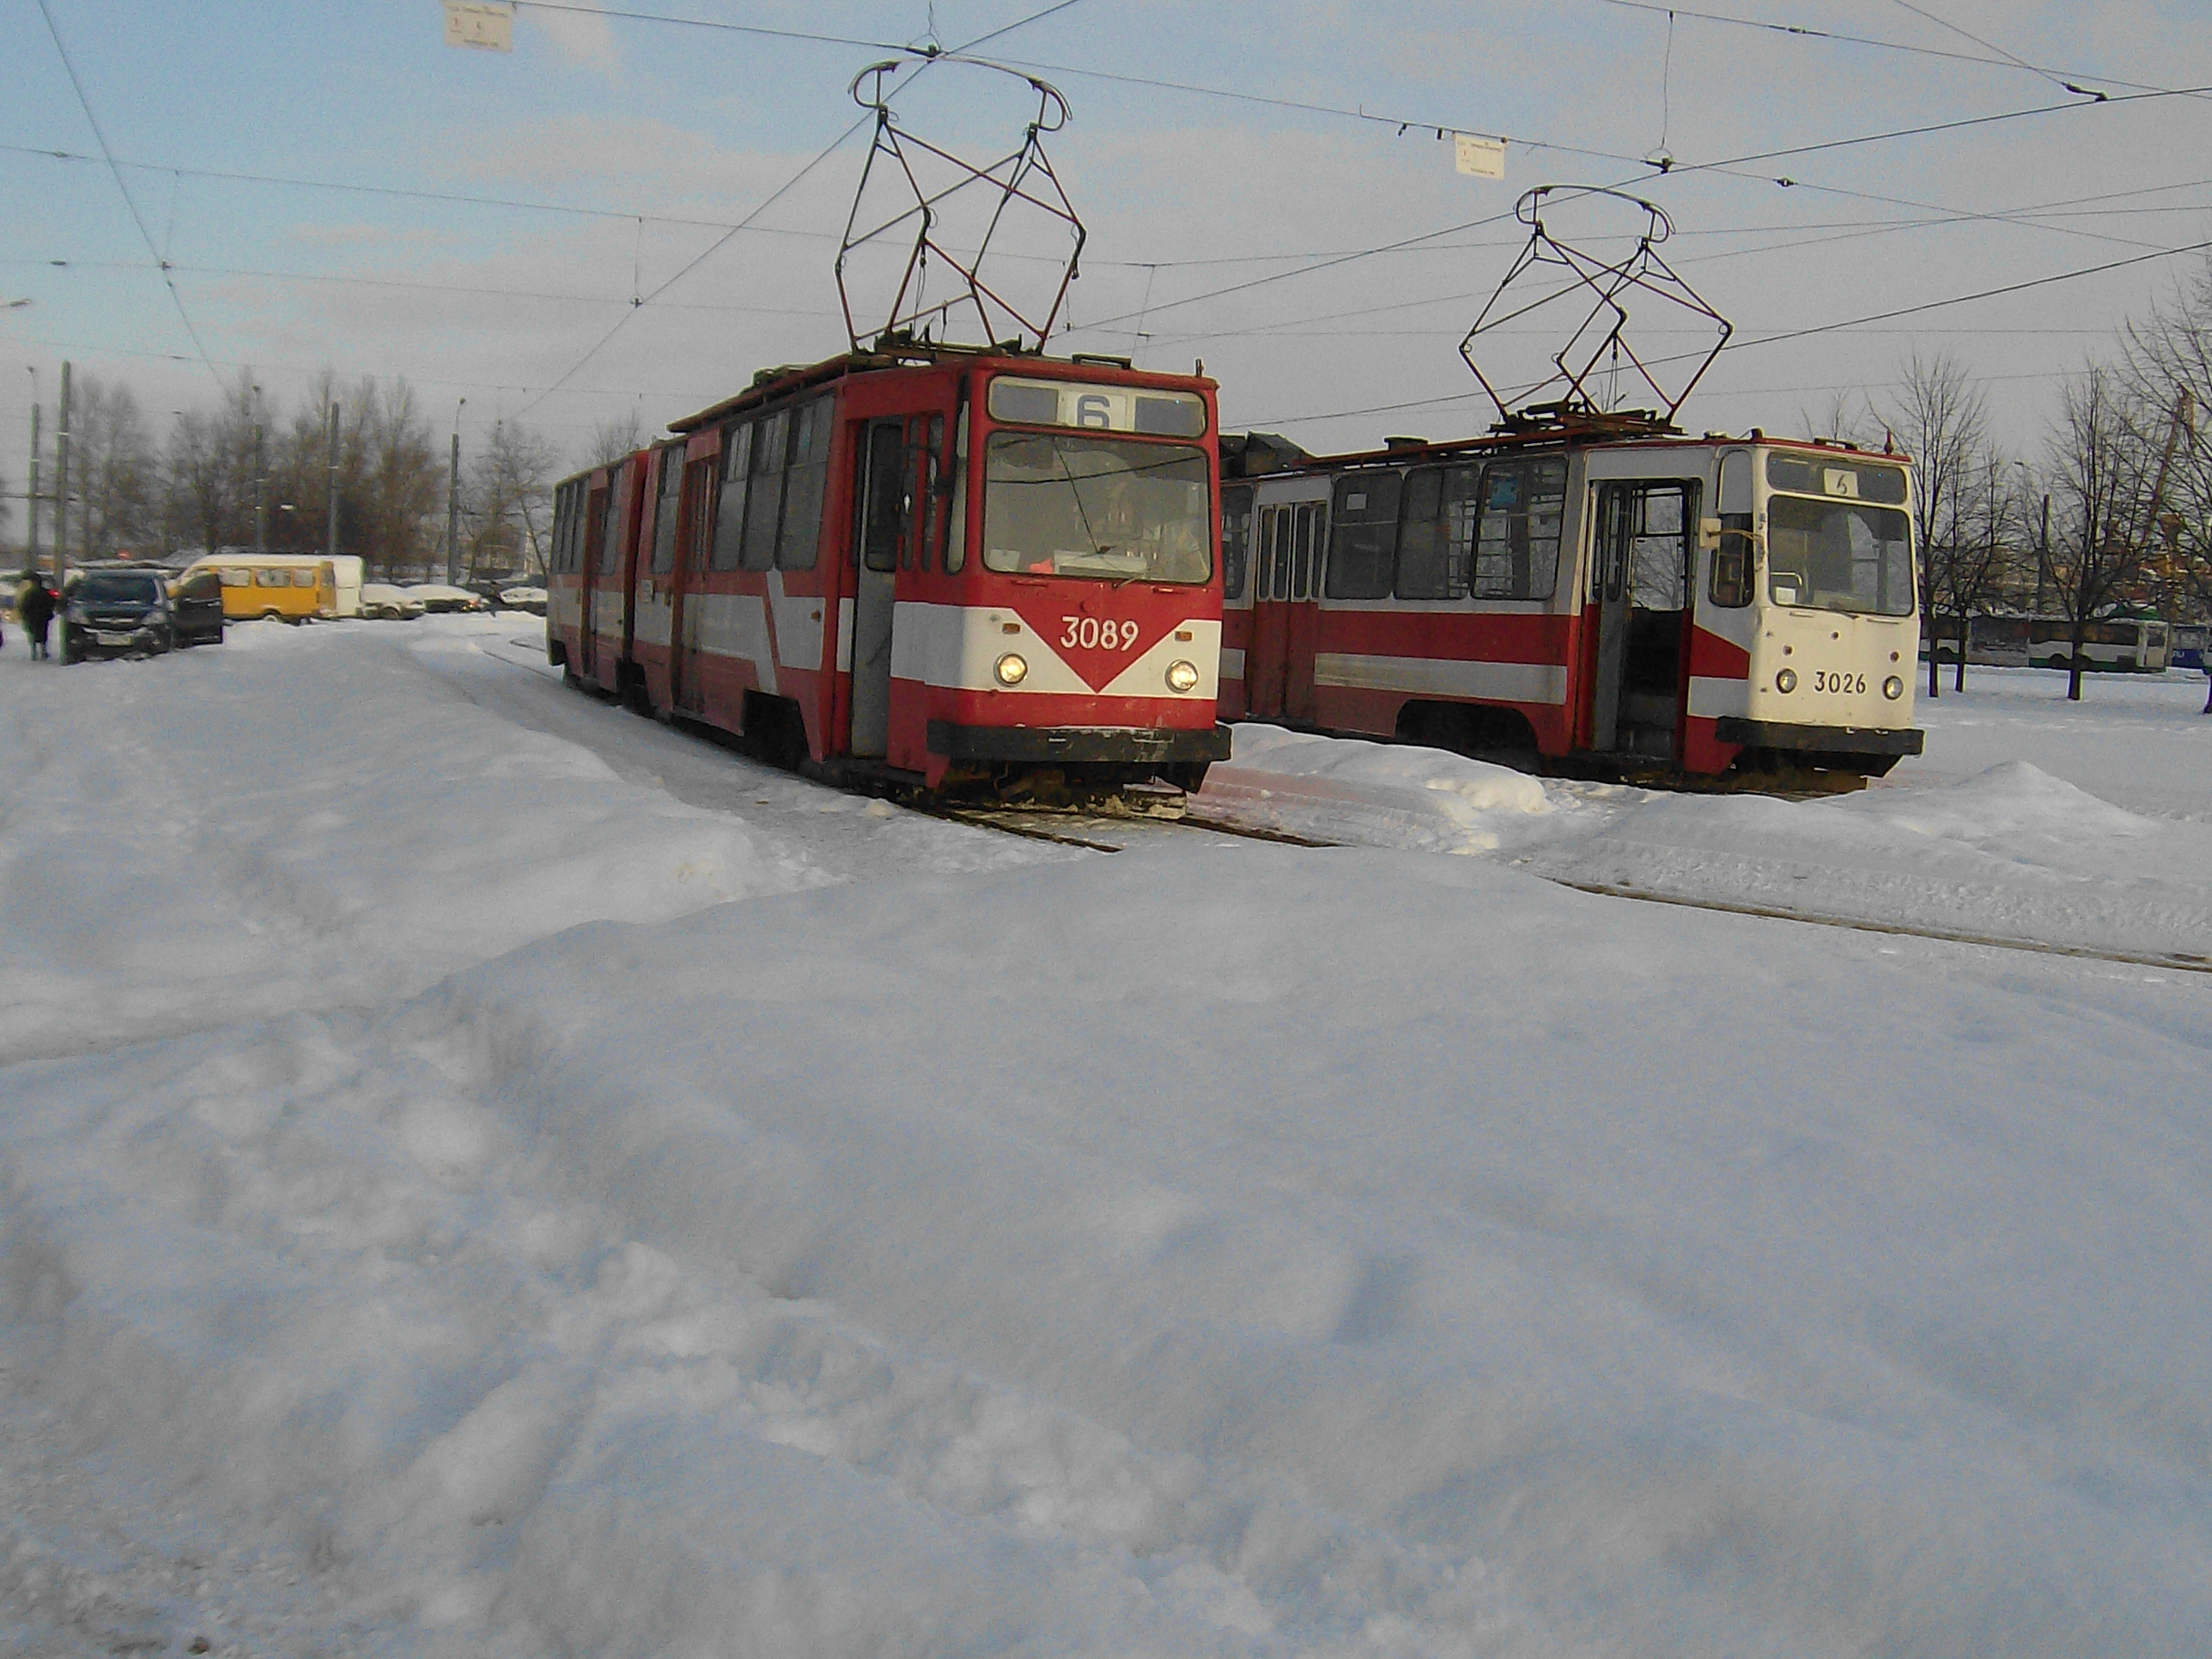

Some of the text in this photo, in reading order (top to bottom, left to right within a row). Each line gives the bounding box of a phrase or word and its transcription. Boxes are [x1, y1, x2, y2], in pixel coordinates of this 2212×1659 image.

[1076, 394, 1111, 429] 6
[1060, 616, 1139, 653] 3089
[1814, 671, 1867, 695] 3026
